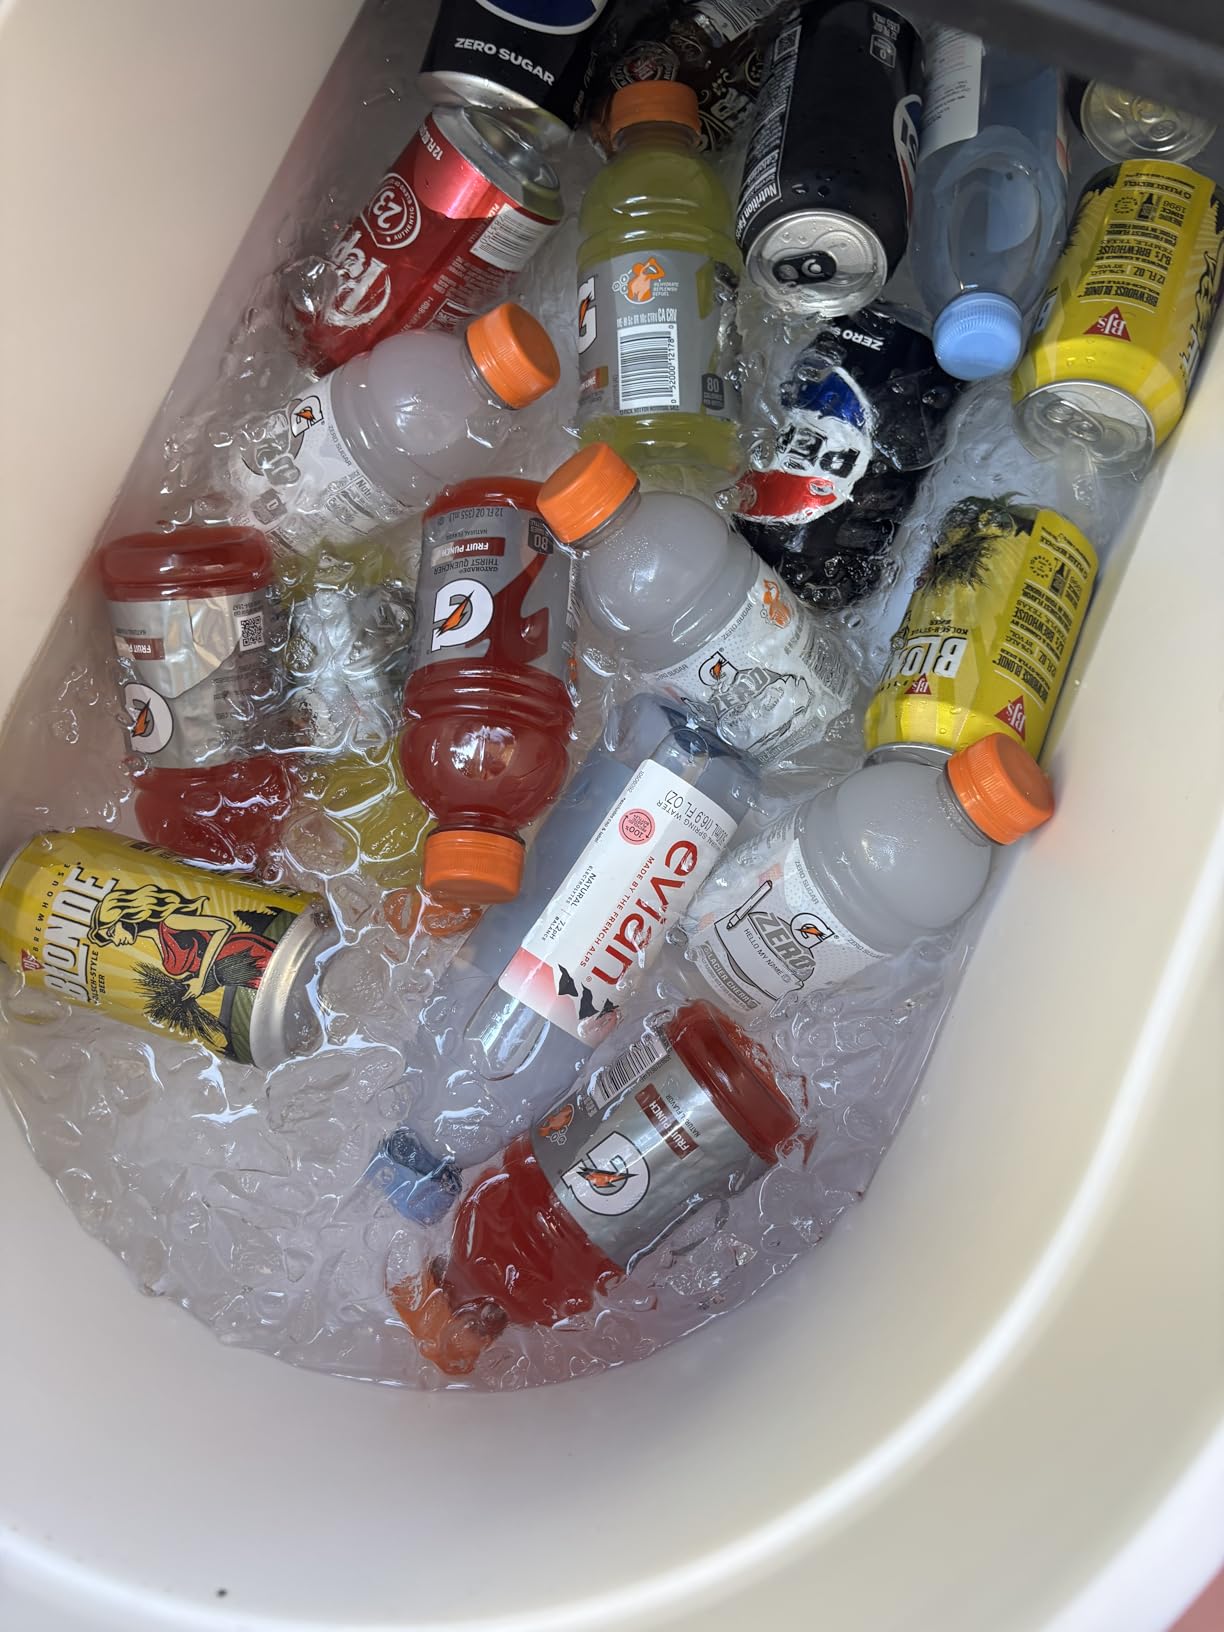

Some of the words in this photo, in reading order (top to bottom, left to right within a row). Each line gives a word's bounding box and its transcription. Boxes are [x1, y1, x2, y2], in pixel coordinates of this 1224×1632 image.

[455, 37, 496, 55] ZERO
[498, 45, 556, 87] SUGAR
[429, 144, 446, 161] 12
[373, 189, 407, 231] 23
[744, 183, 777, 218] Nutrition
[393, 206, 414, 240] AUTHENTIC
[1096, 245, 1150, 258] BREWHOUSE
[1157, 274, 1165, 285] 12
[1115, 285, 1159, 307] BREWHOUSE
[657, 307, 665, 322] CA
[665, 307, 677, 321] CRV
[1098, 309, 1129, 336] BJ's
[841, 328, 883, 350] ZERO
[706, 379, 719, 393] 80
[326, 423, 339, 443] ZERO
[334, 441, 352, 466] SUGAR
[460, 508, 474, 519] (355
[475, 508, 484, 518] OZ
[485, 508, 494, 517] FL
[494, 507, 503, 517] 12
[463, 528, 487, 536] NATURAL
[534, 535, 548, 549] 80
[465, 541, 488, 551] FRUIT
[433, 558, 468, 574] QUENCHER
[470, 557, 497, 566] THIRST
[1017, 600, 1043, 619] TEXAS
[720, 621, 739, 640] ZERO
[734, 602, 754, 625] SUGAR
[1013, 607, 1054, 642] BREWHOUSE
[132, 644, 150, 653] FRUIT
[1000, 654, 1023, 679] BLONDE
[911, 674, 931, 694] BJ's
[1008, 702, 1026, 733] BJ's
[656, 799, 681, 820] WATER
[663, 789, 684, 809] OZ)
[684, 801, 697, 818] FL
[624, 825, 643, 838] 100%
[682, 818, 708, 840] SPRING
[693, 810, 714, 831] (16.9
[635, 854, 655, 882] MADE
[564, 864, 593, 904] ELECTROLYTES
[569, 871, 597, 908] NATURAL
[627, 879, 638, 894] BY
[793, 859, 806, 878] ZERO
[801, 879, 819, 904] SUGAR
[33, 864, 71, 952] BREWHOUSE
[589, 840, 698, 984] evian
[616, 892, 631, 912] THE
[42, 864, 120, 1004] BLONDE
[540, 915, 560, 941] BALANCE
[548, 918, 567, 941] 7.2pH
[592, 908, 619, 947] FRENCH
[578, 943, 596, 968] ALPS
[743, 928, 759, 949] HELLO
[756, 948, 767, 960] MY
[765, 958, 783, 976] NAME
[664, 1091, 682, 1113] FLAVOR
[646, 1099, 672, 1130] PUNCH
